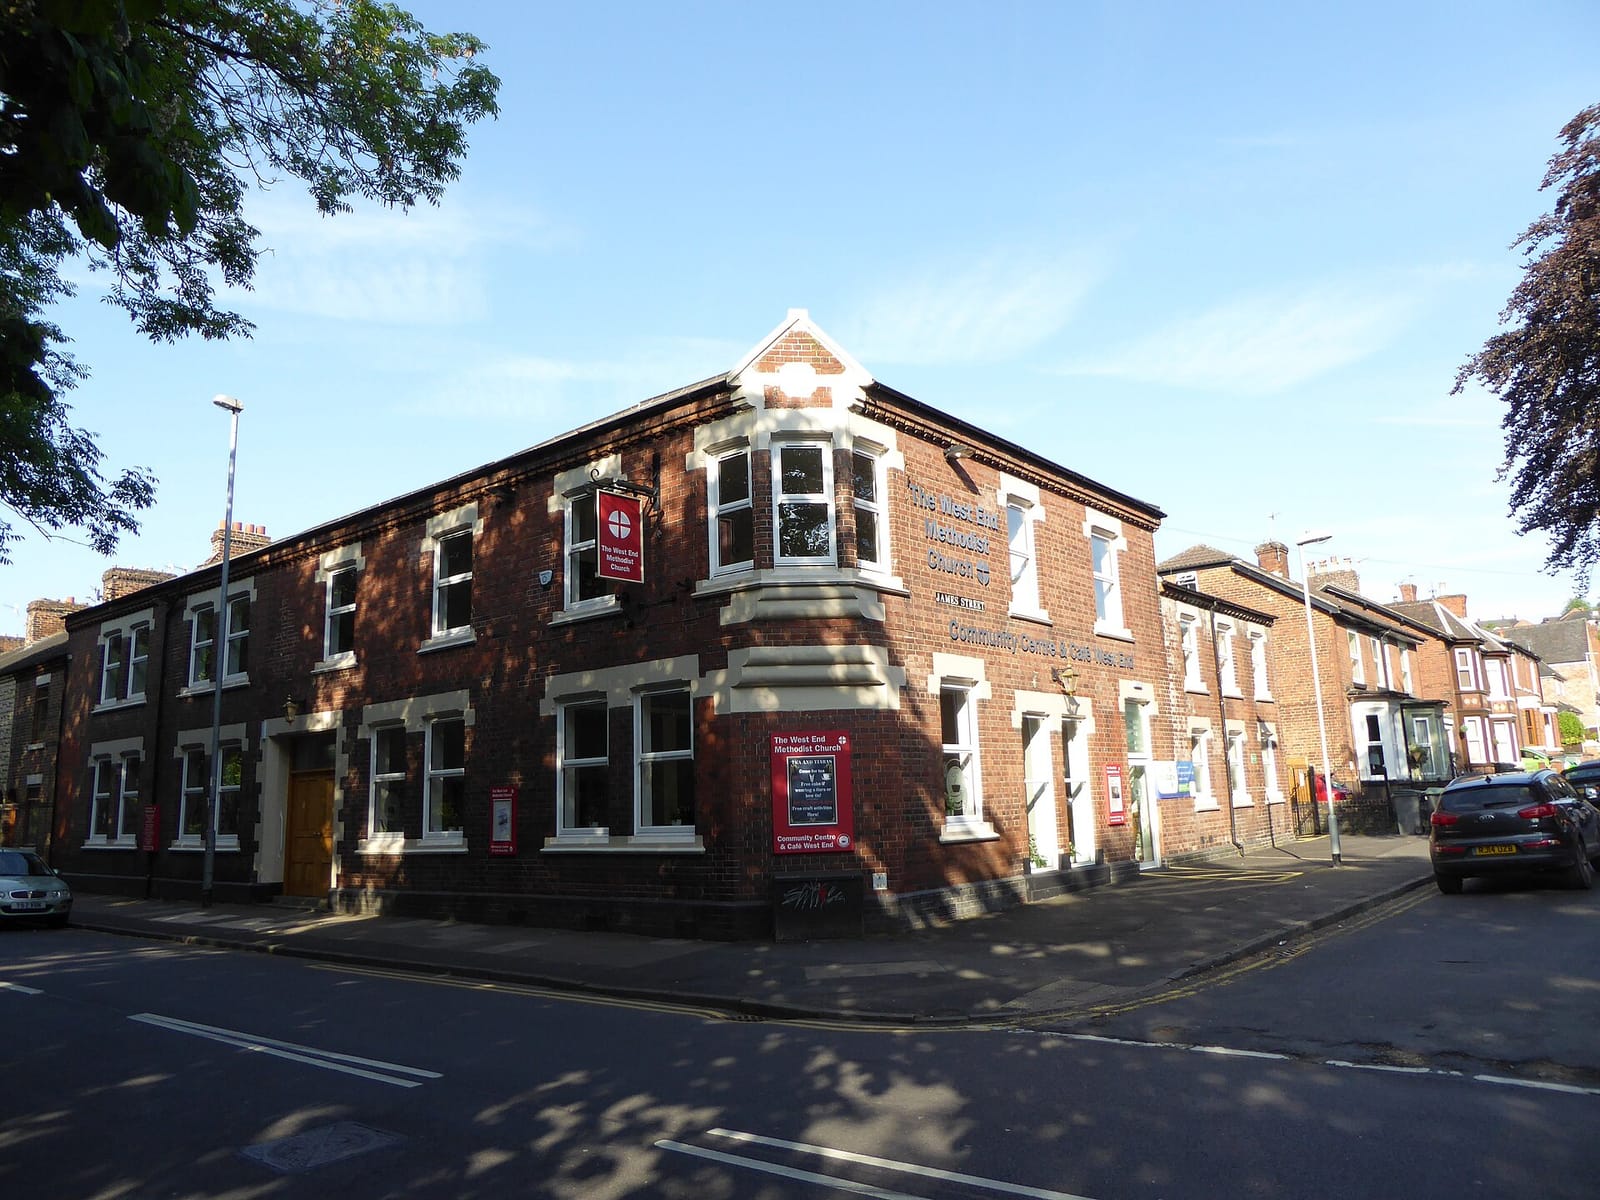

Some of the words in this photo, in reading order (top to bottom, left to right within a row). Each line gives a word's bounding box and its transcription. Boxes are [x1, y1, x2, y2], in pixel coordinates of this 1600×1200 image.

[909, 482, 936, 511] The
[939, 494, 973, 523] West
[976, 507, 998, 532] End
[924, 517, 990, 555] Methodist
[606, 554, 634, 565] Methodist
[613, 546, 627, 555] West
[610, 564, 630, 572] Church
[927, 548, 974, 579] Church
[936, 592, 959, 605] JAMES
[960, 597, 985, 610] STREET
[949, 619, 1018, 654] Community
[1020, 633, 1056, 658] Centre
[1060, 642, 1067, 658] &
[1070, 642, 1091, 662] Café
[1095, 647, 1117, 668] West
[1120, 654, 1134, 670] End
